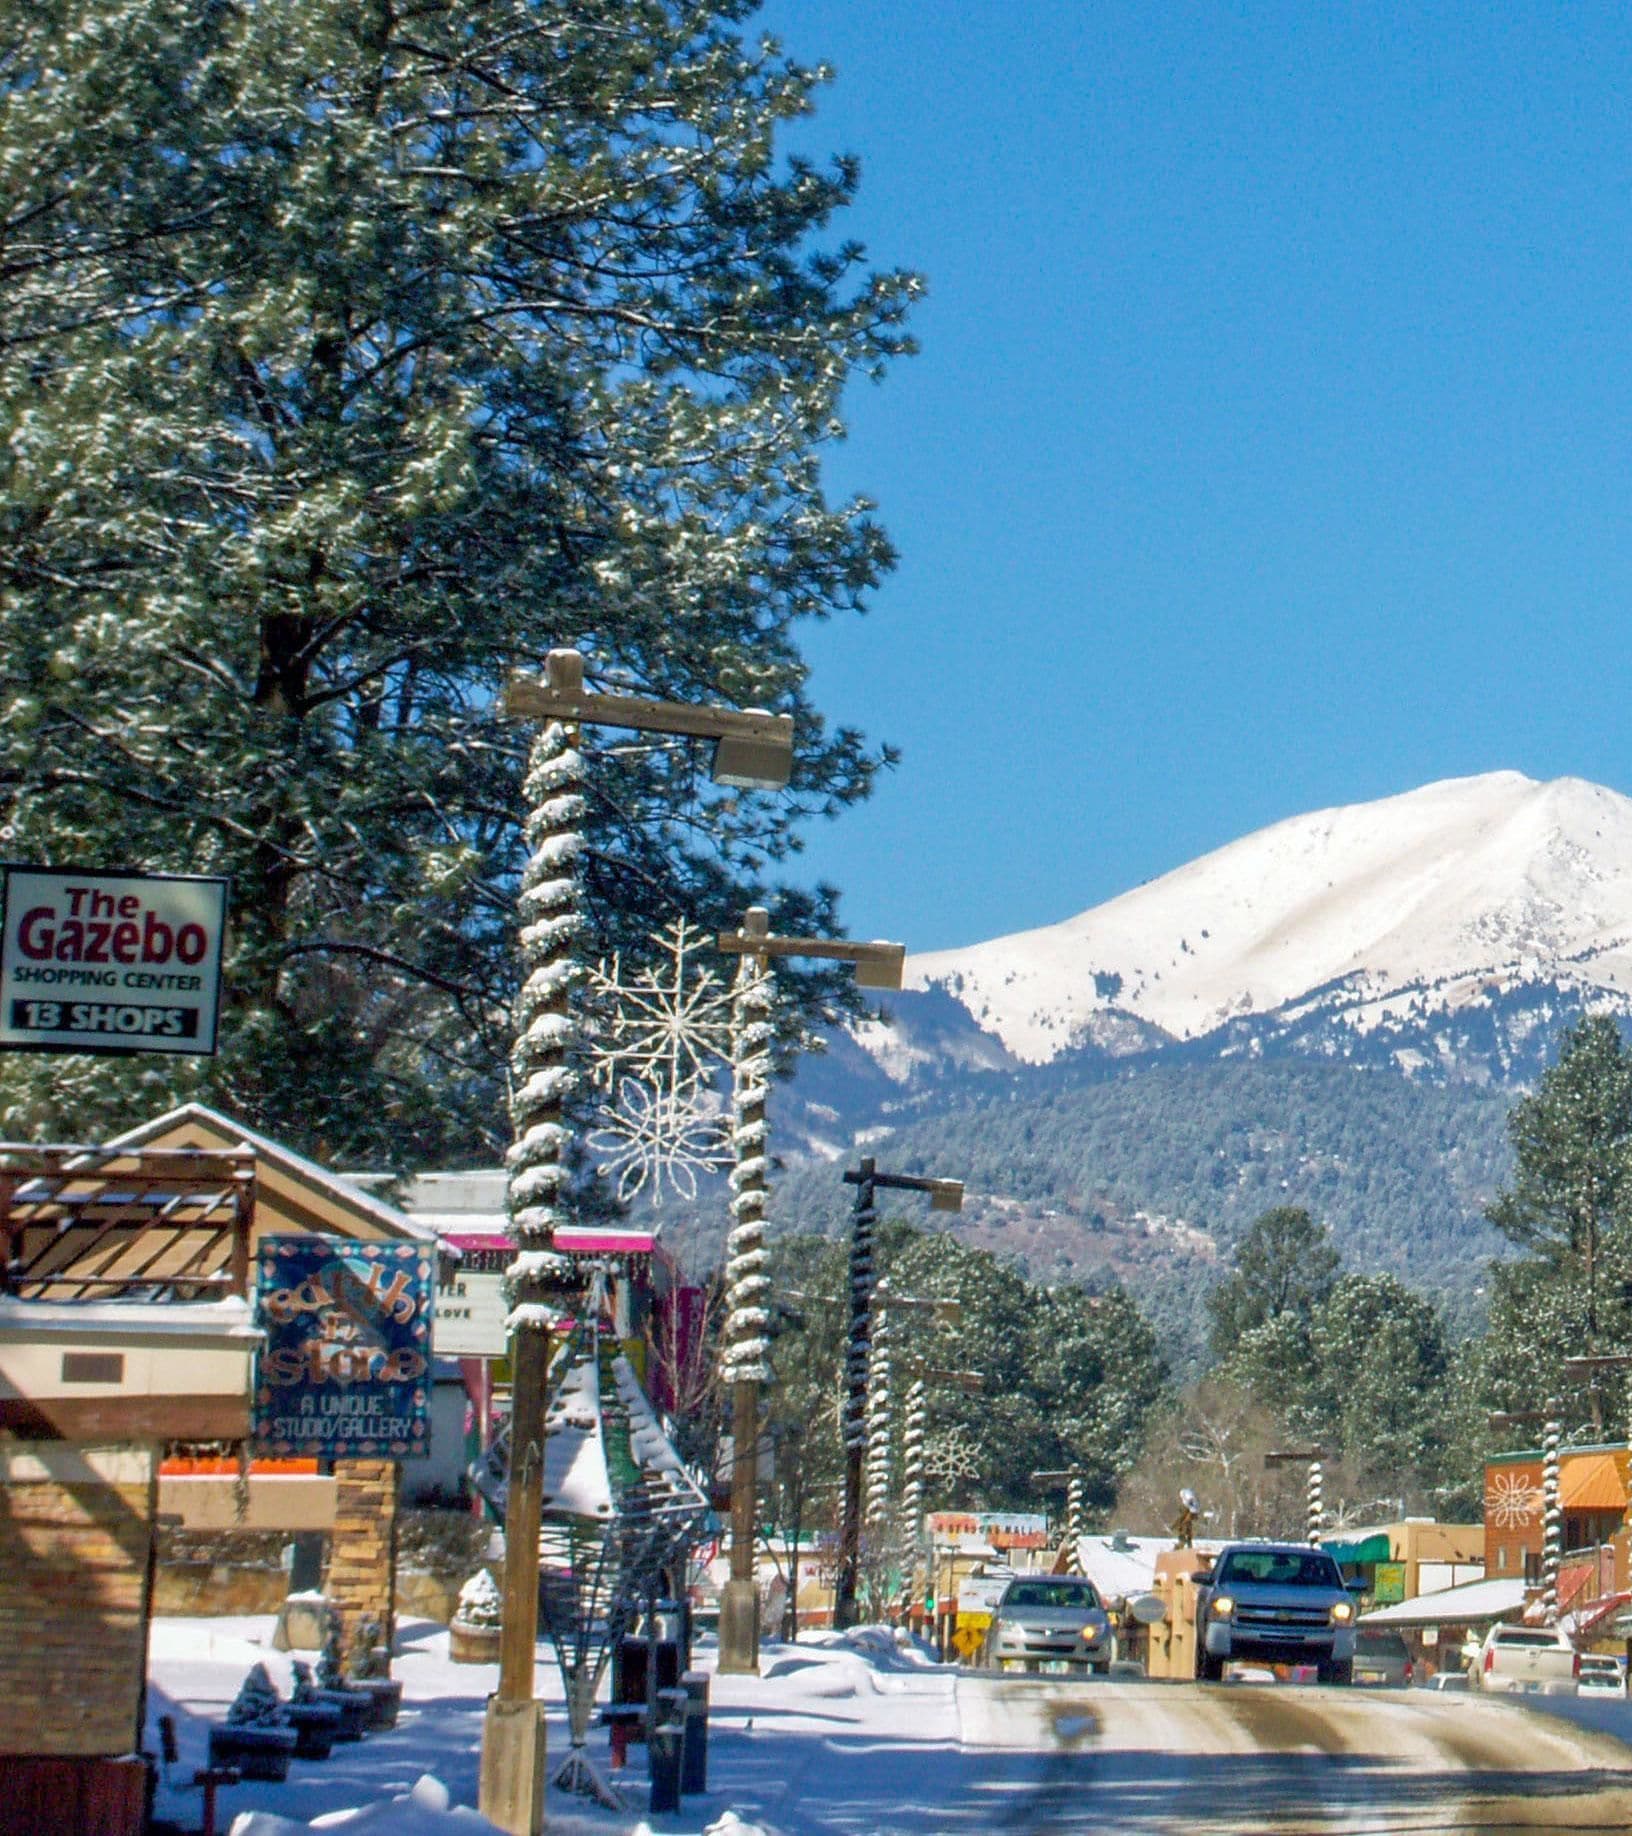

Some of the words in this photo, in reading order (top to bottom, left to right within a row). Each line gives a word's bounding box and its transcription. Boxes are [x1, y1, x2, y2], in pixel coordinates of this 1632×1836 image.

[65, 887, 140, 919] The
[18, 906, 208, 966] Gazebo
[13, 966, 117, 987] SHOPPING
[123, 971, 202, 991] CENTER
[25, 1002, 62, 1028] 13
[70, 1004, 184, 1035] SHOPS
[300, 1395, 314, 1415] A
[320, 1394, 384, 1416] UNIQUE
[273, 1416, 412, 1439] STUDIO/GALLERY
